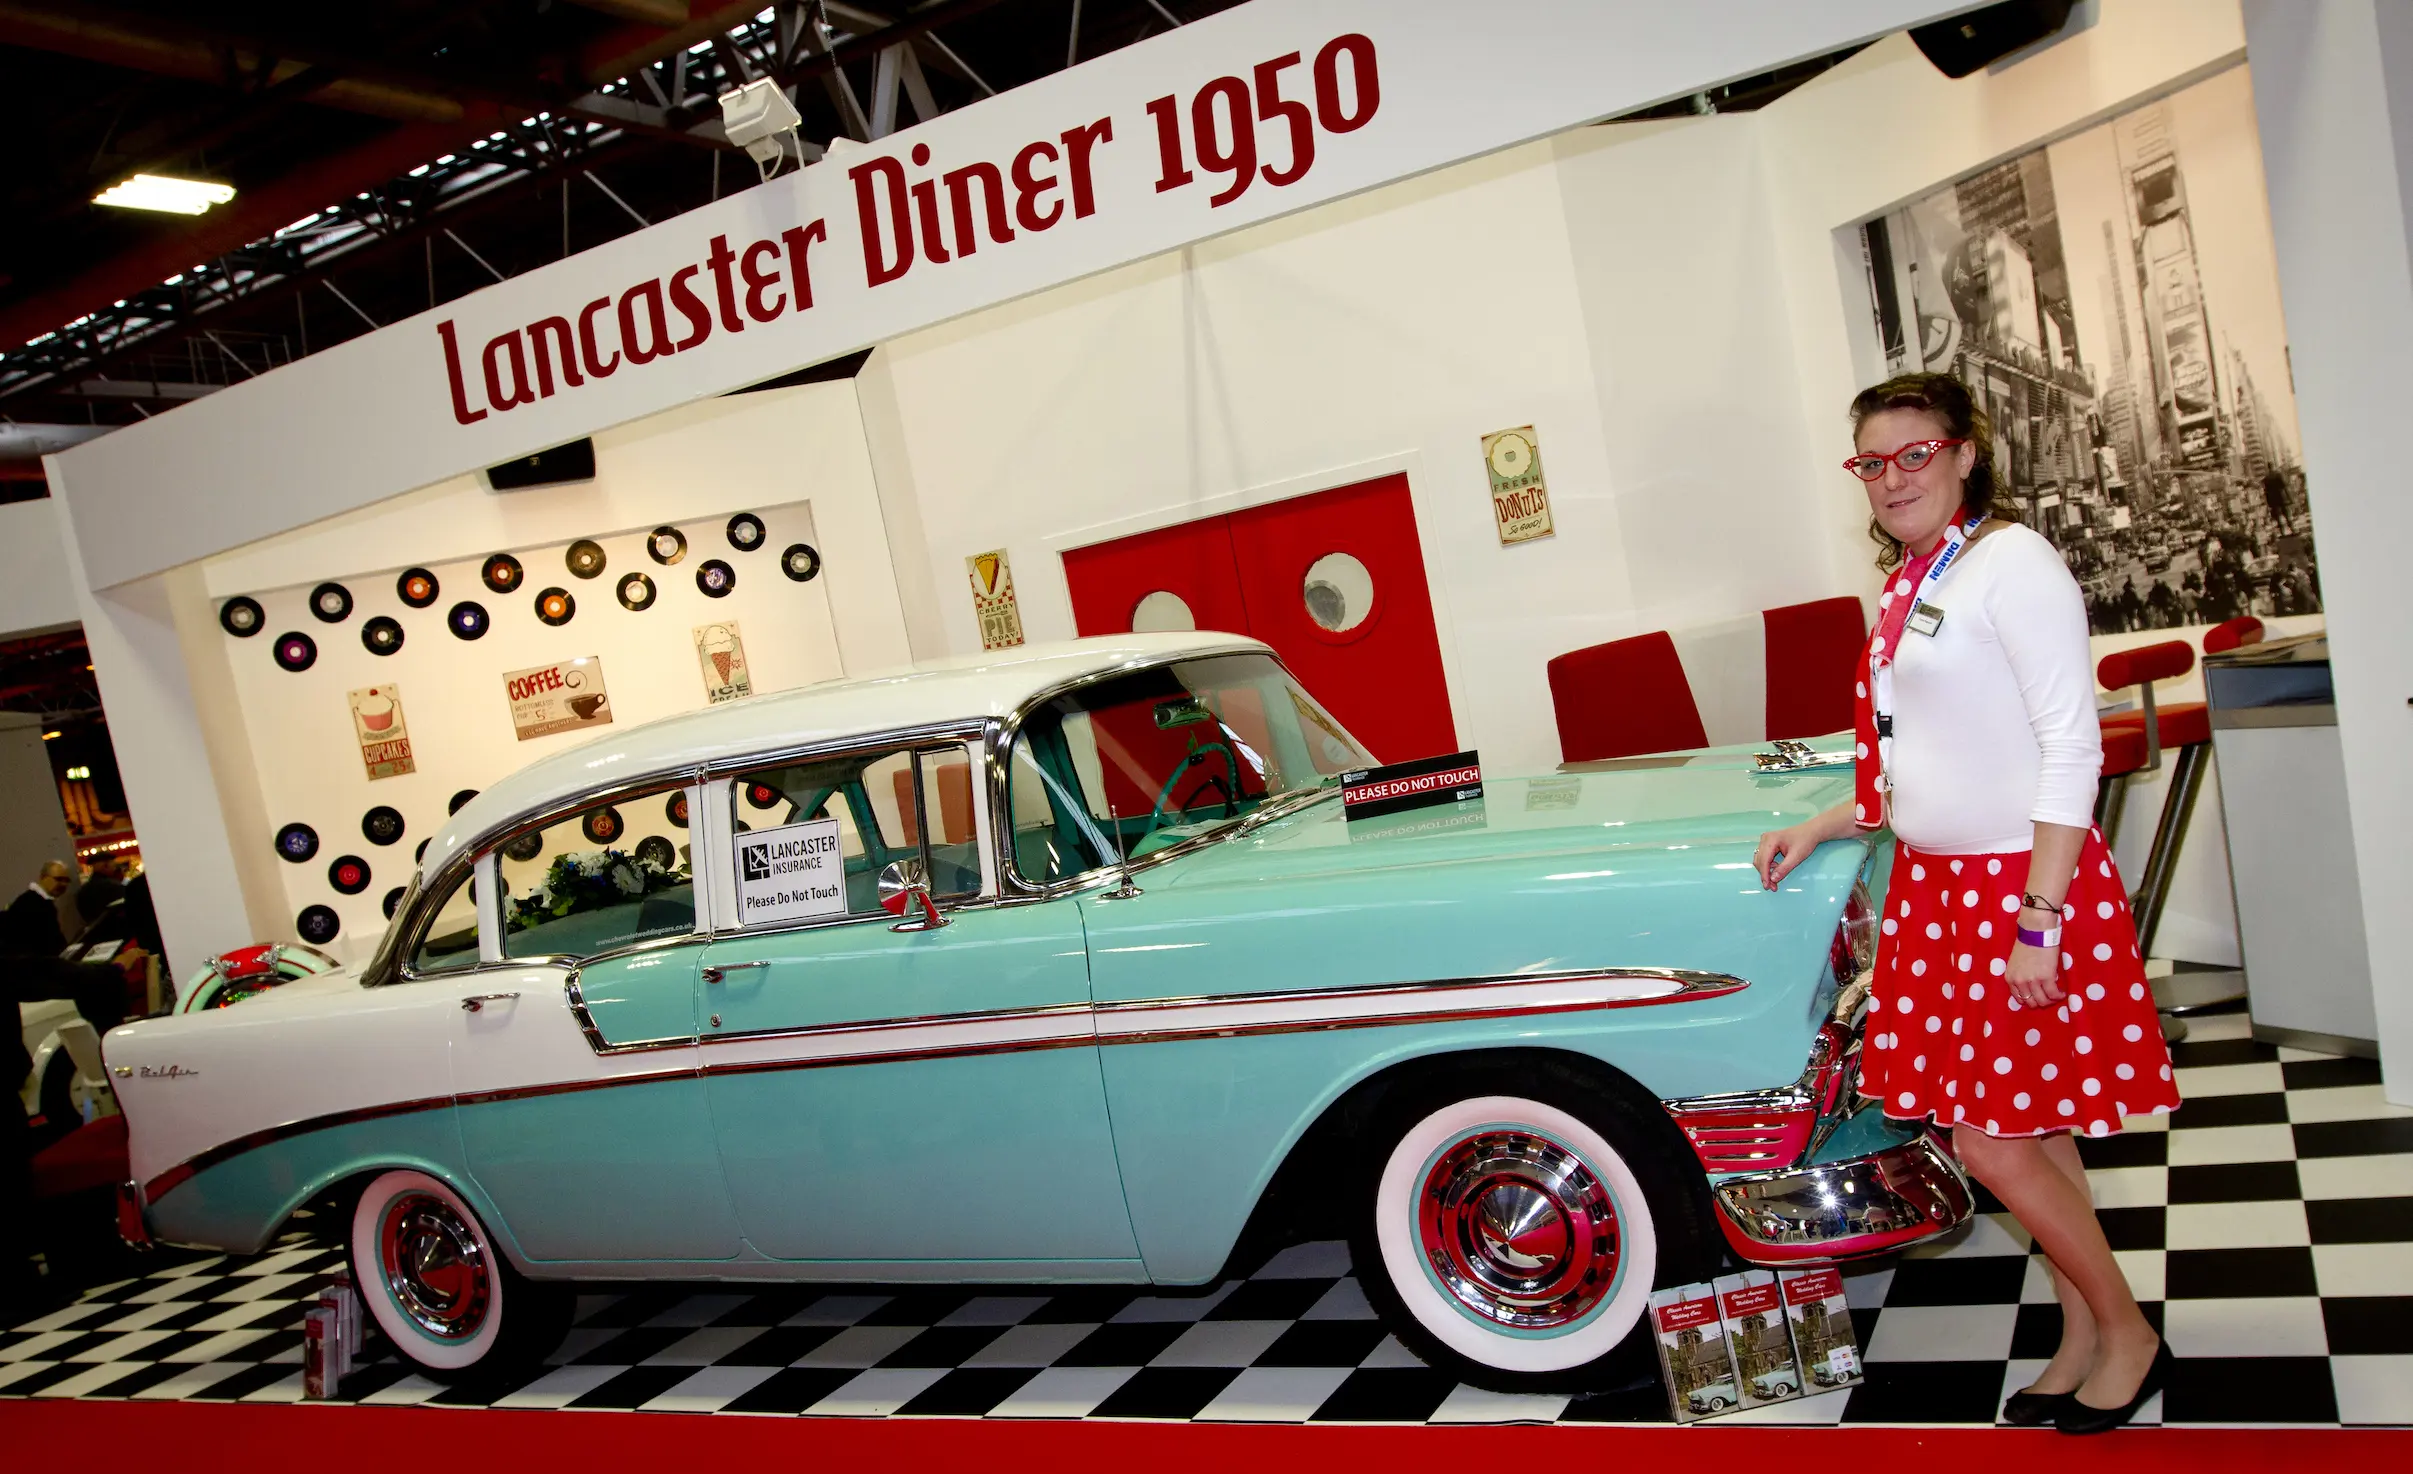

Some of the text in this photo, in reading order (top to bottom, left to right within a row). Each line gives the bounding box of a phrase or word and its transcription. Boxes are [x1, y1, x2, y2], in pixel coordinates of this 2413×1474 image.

[436, 32, 1381, 426] Lancaster Diner 1950
[1493, 475, 1541, 492] FRESH
[1495, 486, 1544, 523] DONUTS
[1928, 541, 1960, 581] DAMEN
[984, 614, 1016, 638] PIE
[507, 666, 565, 701] COFFEE
[710, 681, 750, 697] ICE
[363, 739, 411, 764] CUPCAKES
[1345, 768, 1480, 803] PLEASE DO NOT TOUCH
[771, 835, 837, 860] LANCASTER
[772, 856, 823, 875] INSURANCE
[747, 884, 839, 909] Please Do Not Touch
